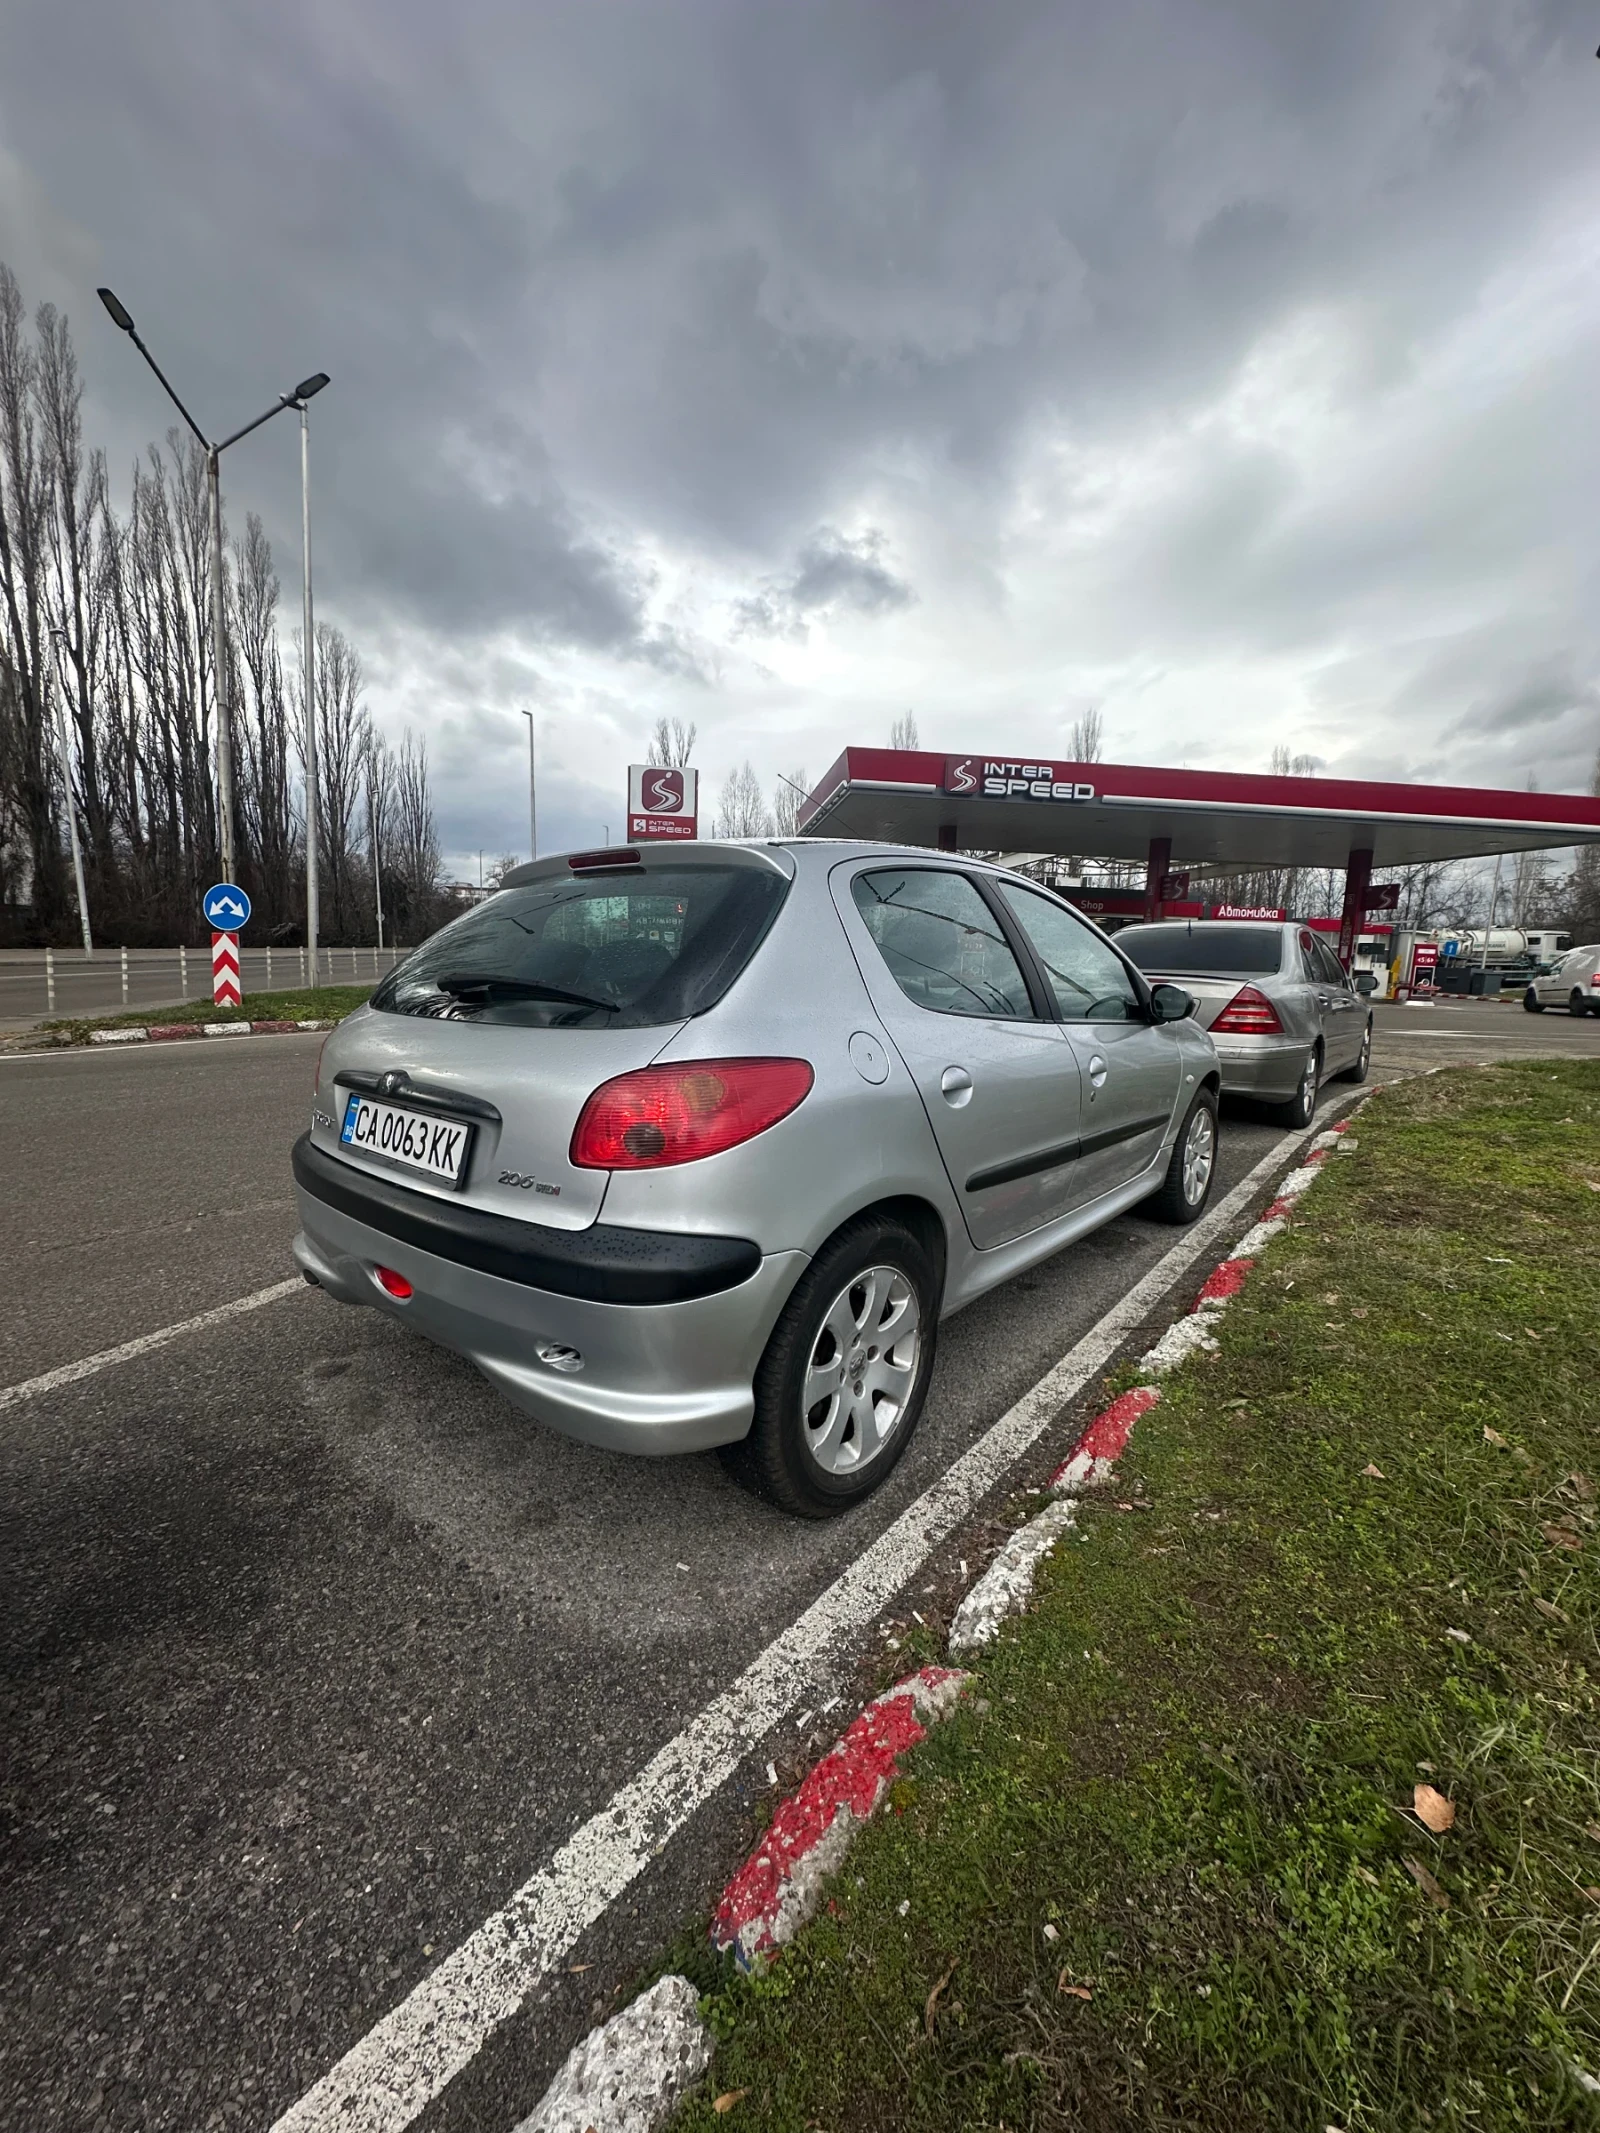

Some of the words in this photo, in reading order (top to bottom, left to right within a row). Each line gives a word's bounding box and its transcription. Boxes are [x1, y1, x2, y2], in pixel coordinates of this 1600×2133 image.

[984, 762, 1054, 778] INTER
[984, 777, 1095, 800] SPEED
[648, 825, 691, 834] SPEED
[1080, 900, 1104, 912] Shop
[1218, 905, 1279, 919] Автомивка
[344, 1125, 354, 1136] BG
[498, 1169, 535, 1189] 206
